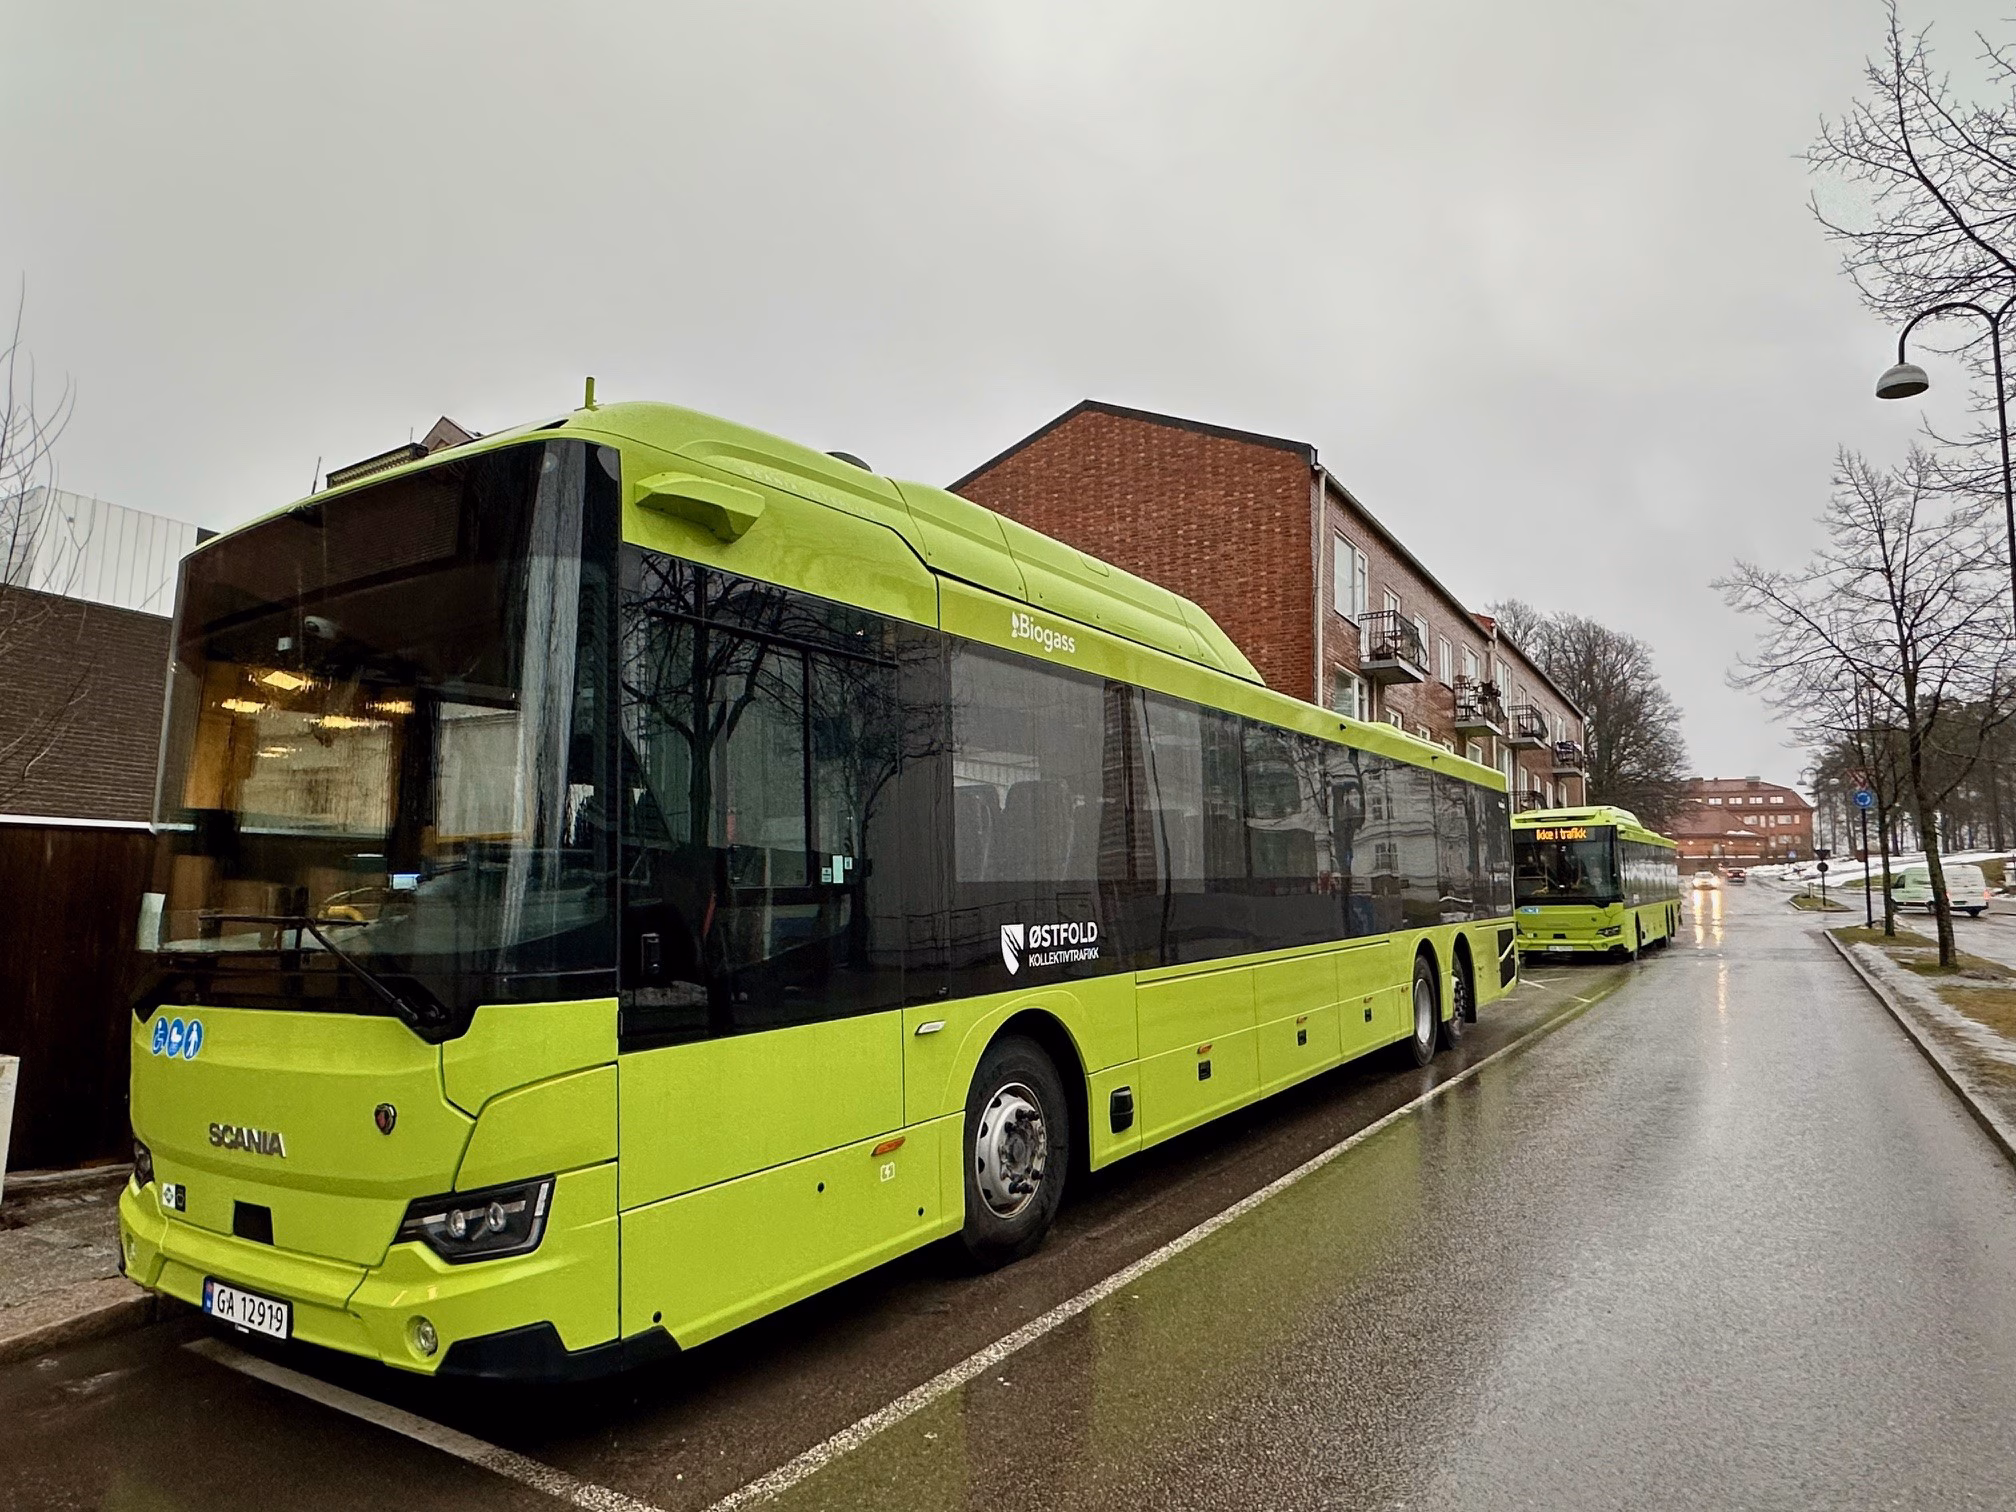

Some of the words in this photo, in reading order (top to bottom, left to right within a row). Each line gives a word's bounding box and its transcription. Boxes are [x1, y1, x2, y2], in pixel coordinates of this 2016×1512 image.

[1019, 613, 1075, 653] Biogass
[1029, 922, 1098, 949] ØSTFOLD
[1029, 947, 1099, 967] KOLLEKTIVTRAFIKK
[209, 1123, 286, 1159] SCANIA
[217, 1289, 234, 1317] GA
[241, 1296, 283, 1332] 12919
